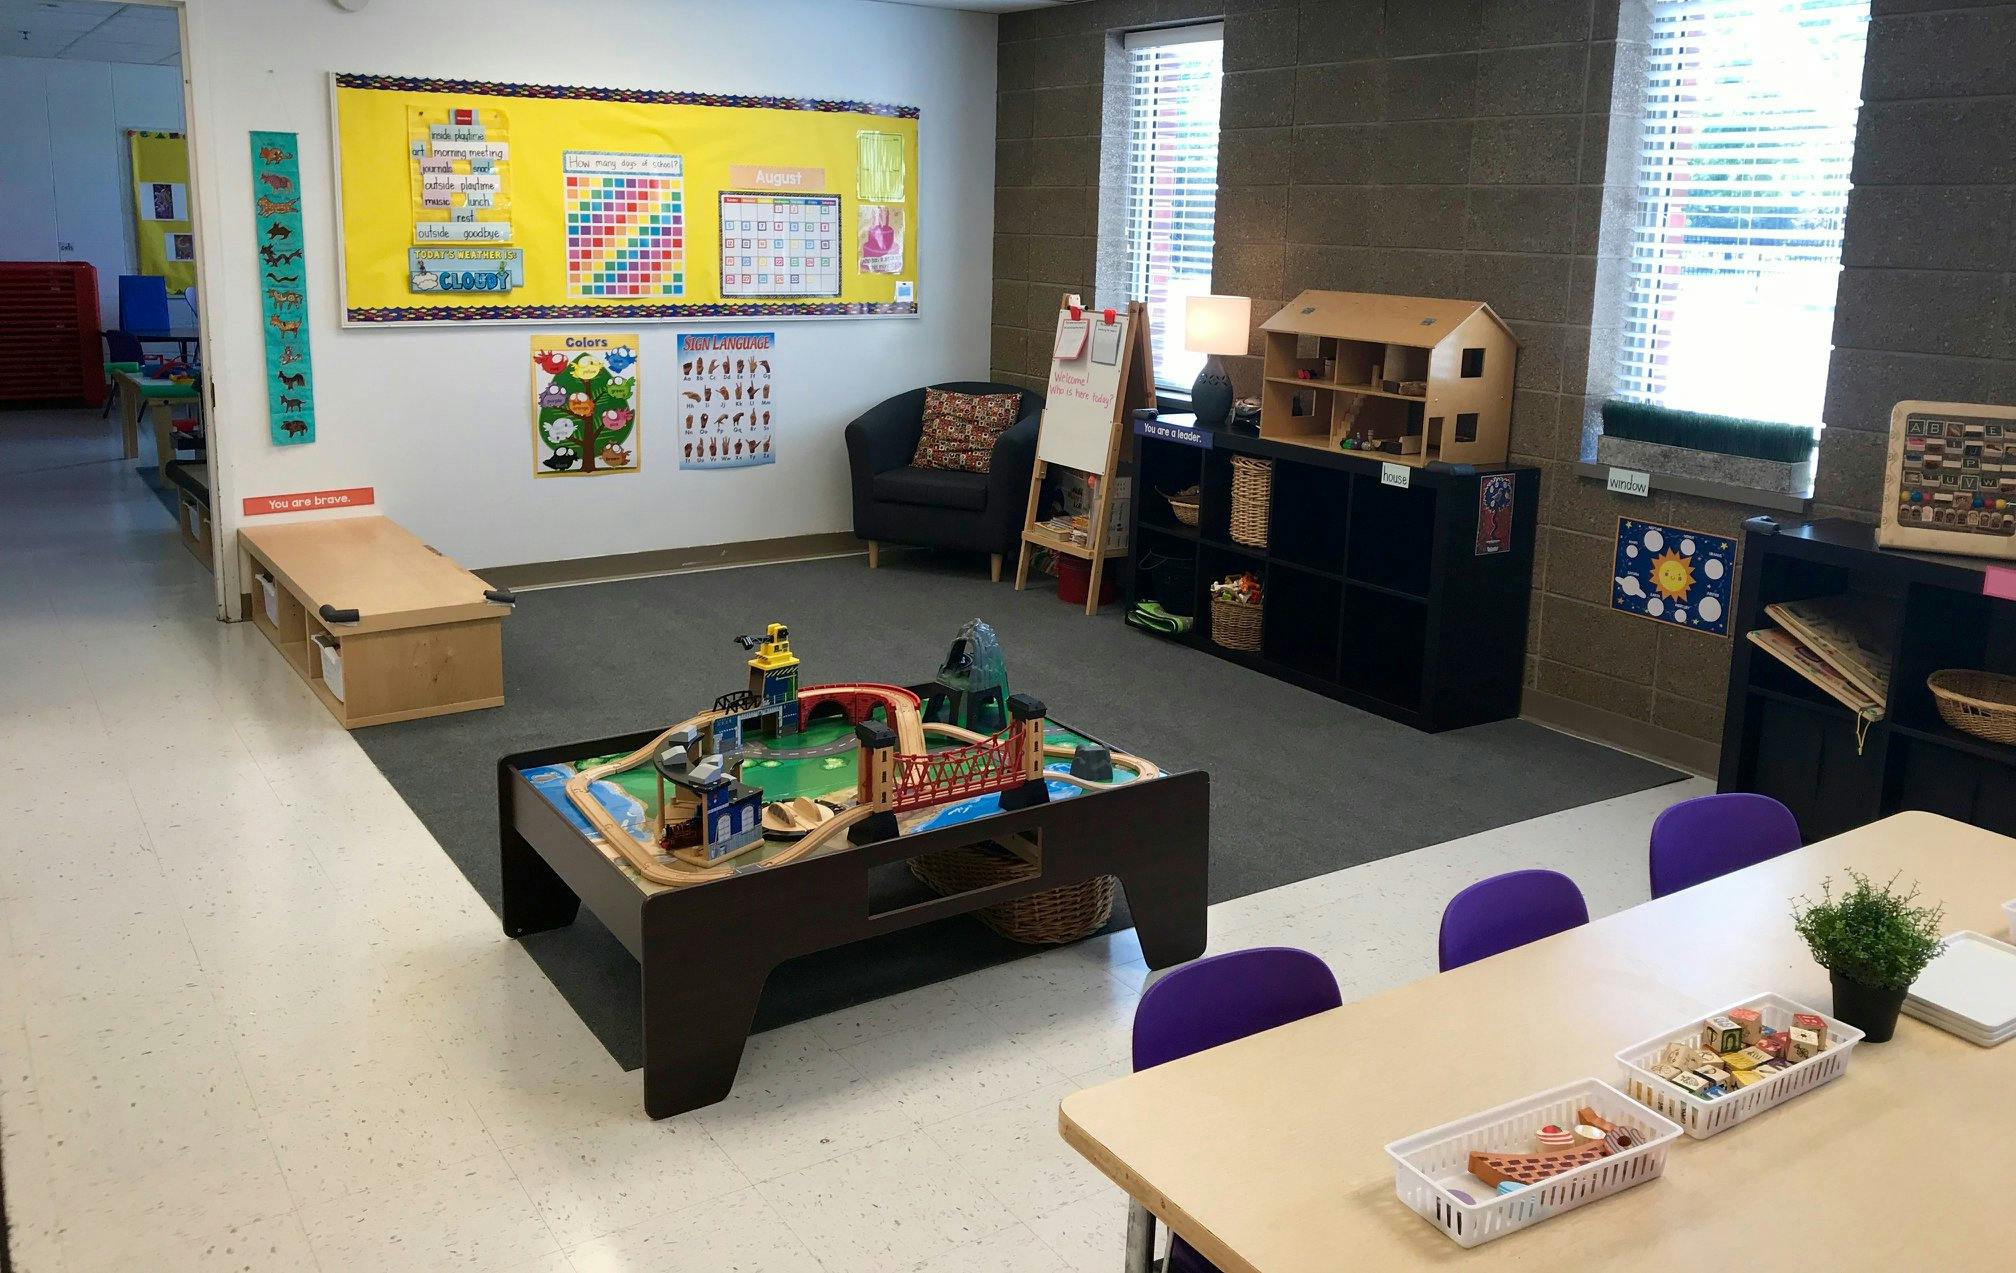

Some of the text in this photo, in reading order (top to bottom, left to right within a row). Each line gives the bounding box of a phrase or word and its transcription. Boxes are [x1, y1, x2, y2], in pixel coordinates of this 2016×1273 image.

[432, 128, 484, 141] inside playtime
[412, 144, 424, 156] art
[434, 145, 503, 160] morning meeting
[421, 160, 452, 176] journals
[569, 156, 590, 168] How
[596, 160, 616, 170] many
[622, 160, 638, 169] days
[425, 176, 495, 192] outside playtime
[756, 170, 802, 186] August
[425, 197, 450, 206] music
[467, 194, 490, 206] lunch
[456, 210, 474, 222] rest
[418, 225, 500, 240] outside goodbye
[415, 250, 518, 260] TODAY'S WEATHER IS:
[439, 271, 510, 290] CLOUDY
[566, 337, 608, 348] Colors
[683, 335, 770, 351] SIGN LANGUAGE
[1054, 372, 1090, 386] Welcome!
[1050, 385, 1064, 396] Who
[1076, 390, 1089, 400] here
[1092, 394, 1114, 409] today?
[1144, 422, 1156, 434] You
[1157, 428, 1170, 436] are
[1178, 429, 1202, 443] leader.
[1910, 423, 1997, 435] A B E
[1383, 470, 1407, 486] house
[1610, 474, 1647, 493] window
[1966, 478, 1974, 488] V
[268, 496, 351, 510] You are brave.
